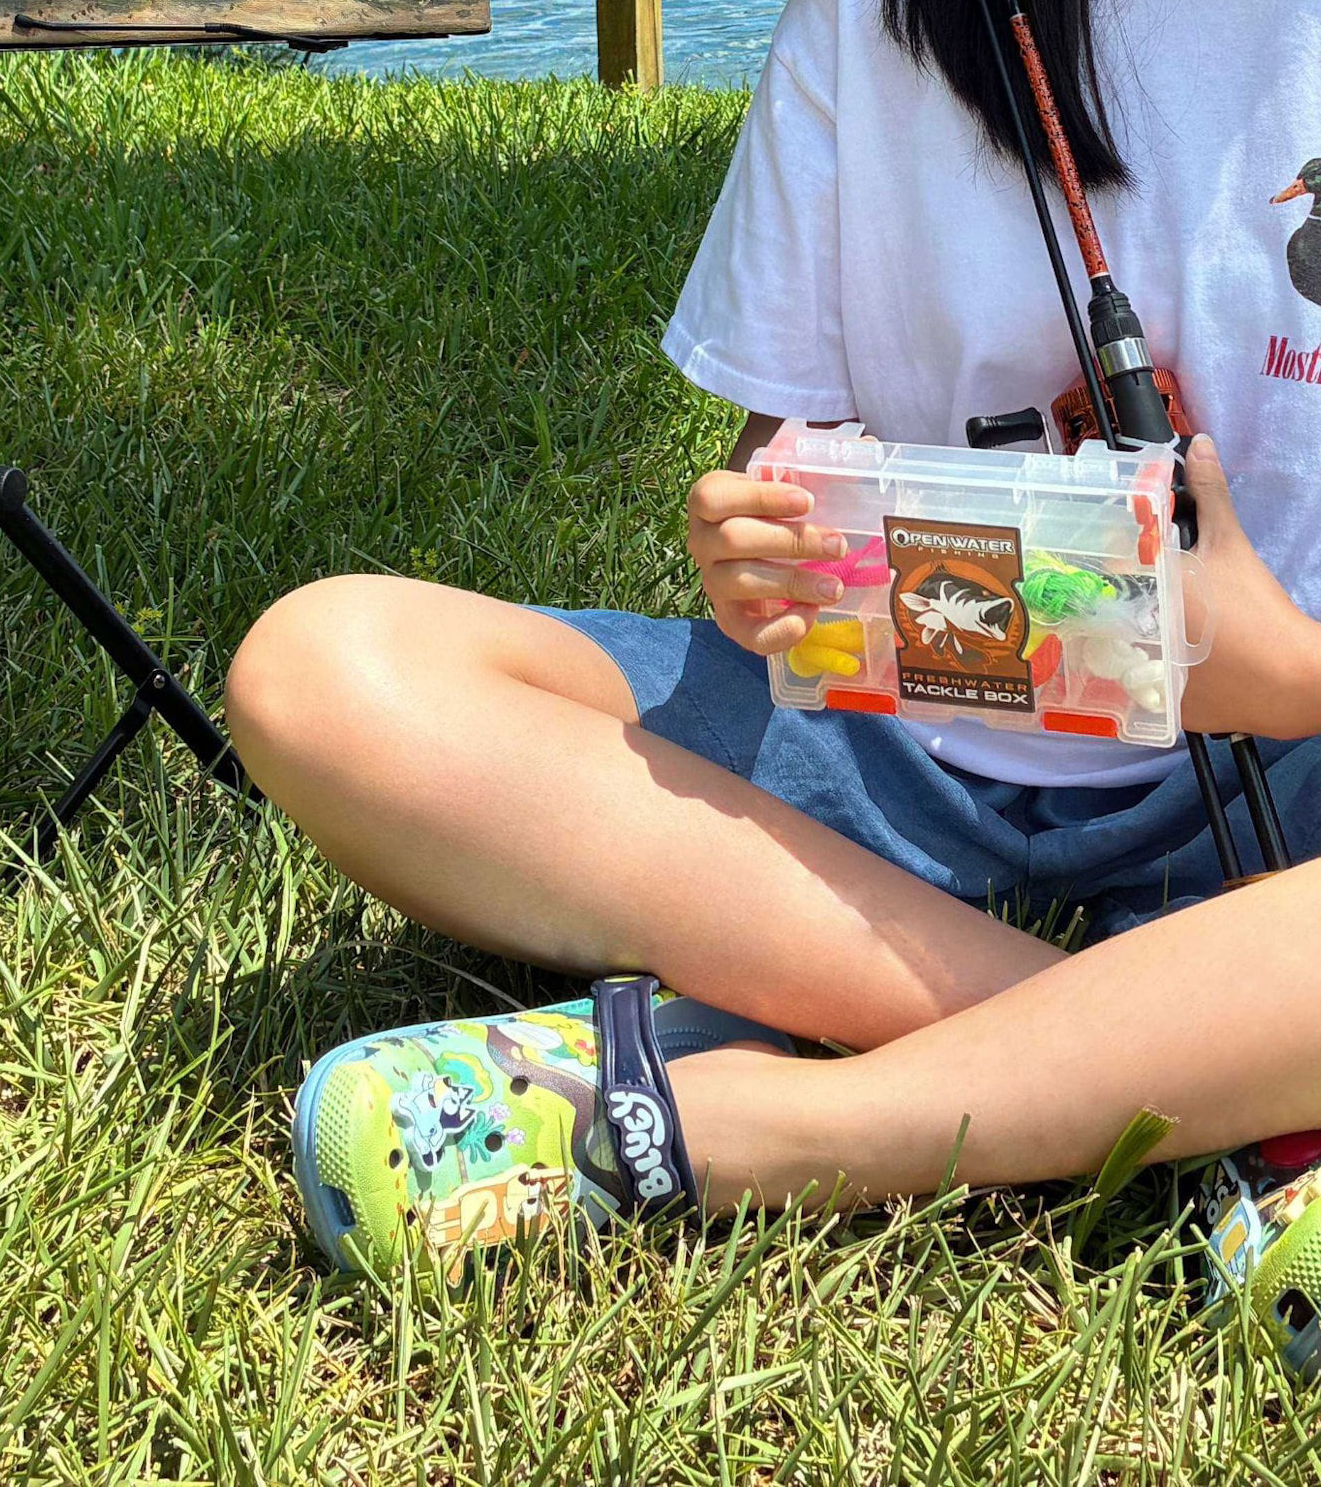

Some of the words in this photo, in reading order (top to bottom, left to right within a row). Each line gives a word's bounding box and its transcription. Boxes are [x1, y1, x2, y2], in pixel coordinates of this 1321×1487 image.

[918, 547, 999, 559] FISHING
[902, 672, 1028, 692] FRESHWATER
[902, 681, 979, 700] TACKLE
[984, 691, 1029, 705] BOX
